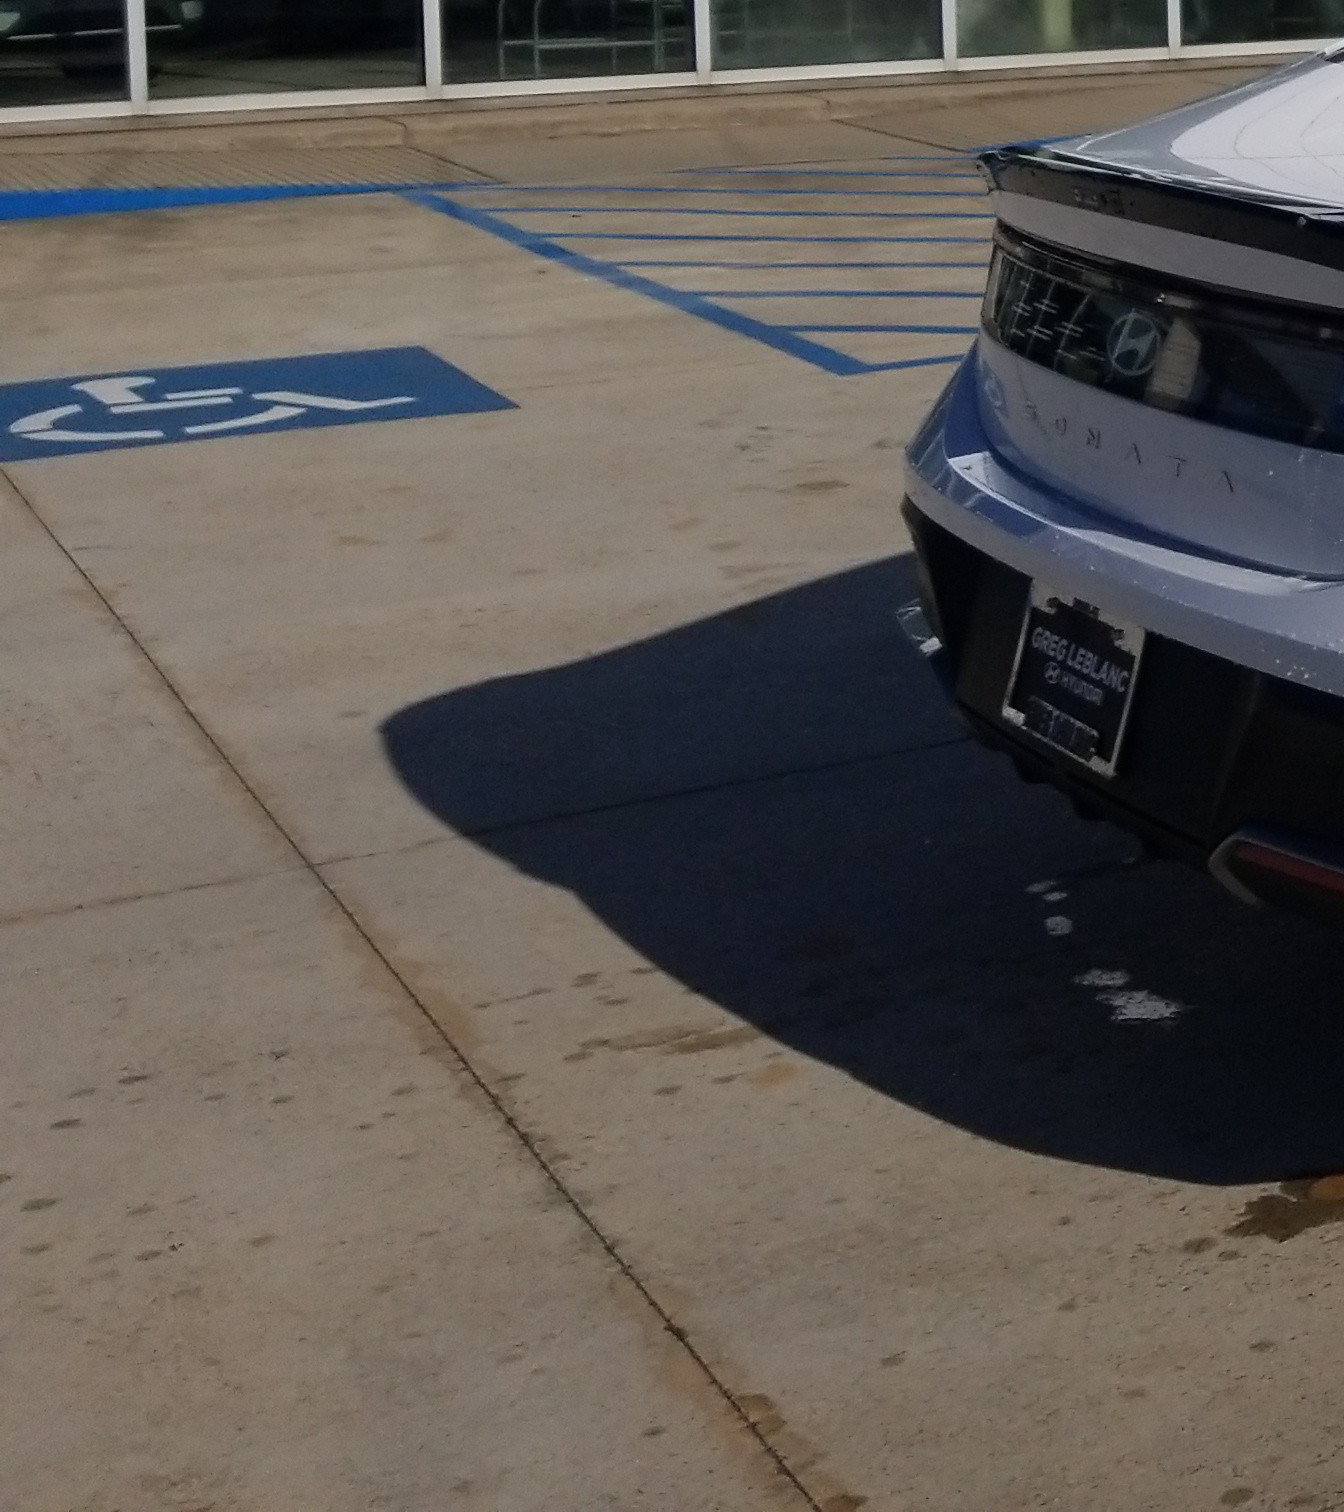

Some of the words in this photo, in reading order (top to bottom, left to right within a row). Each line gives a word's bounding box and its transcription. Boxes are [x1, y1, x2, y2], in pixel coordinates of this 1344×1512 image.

[1025, 399, 1236, 494] SONATA
[1031, 626, 1069, 663] GREG
[1065, 643, 1131, 694] LEBLANC
